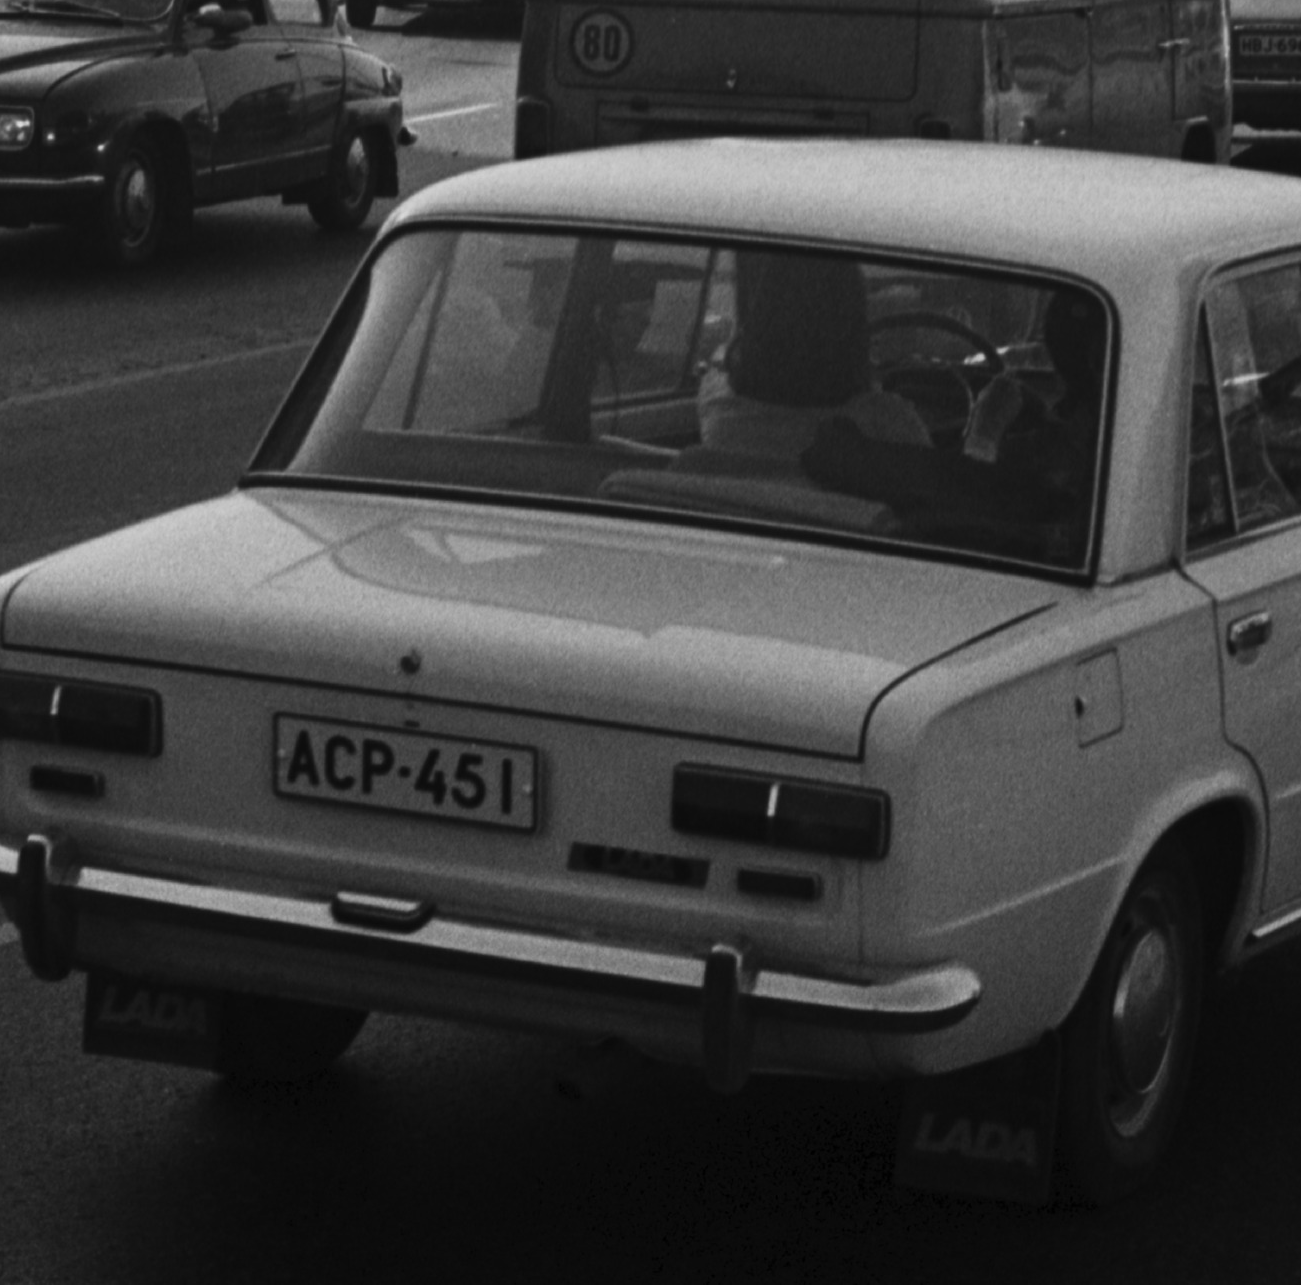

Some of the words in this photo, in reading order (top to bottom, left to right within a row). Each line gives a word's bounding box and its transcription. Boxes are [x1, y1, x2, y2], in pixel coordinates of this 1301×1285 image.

[584, 24, 621, 62] 80
[286, 729, 513, 816] ACP-451
[98, 984, 206, 1036] LADA
[913, 1111, 1037, 1168] LADA
